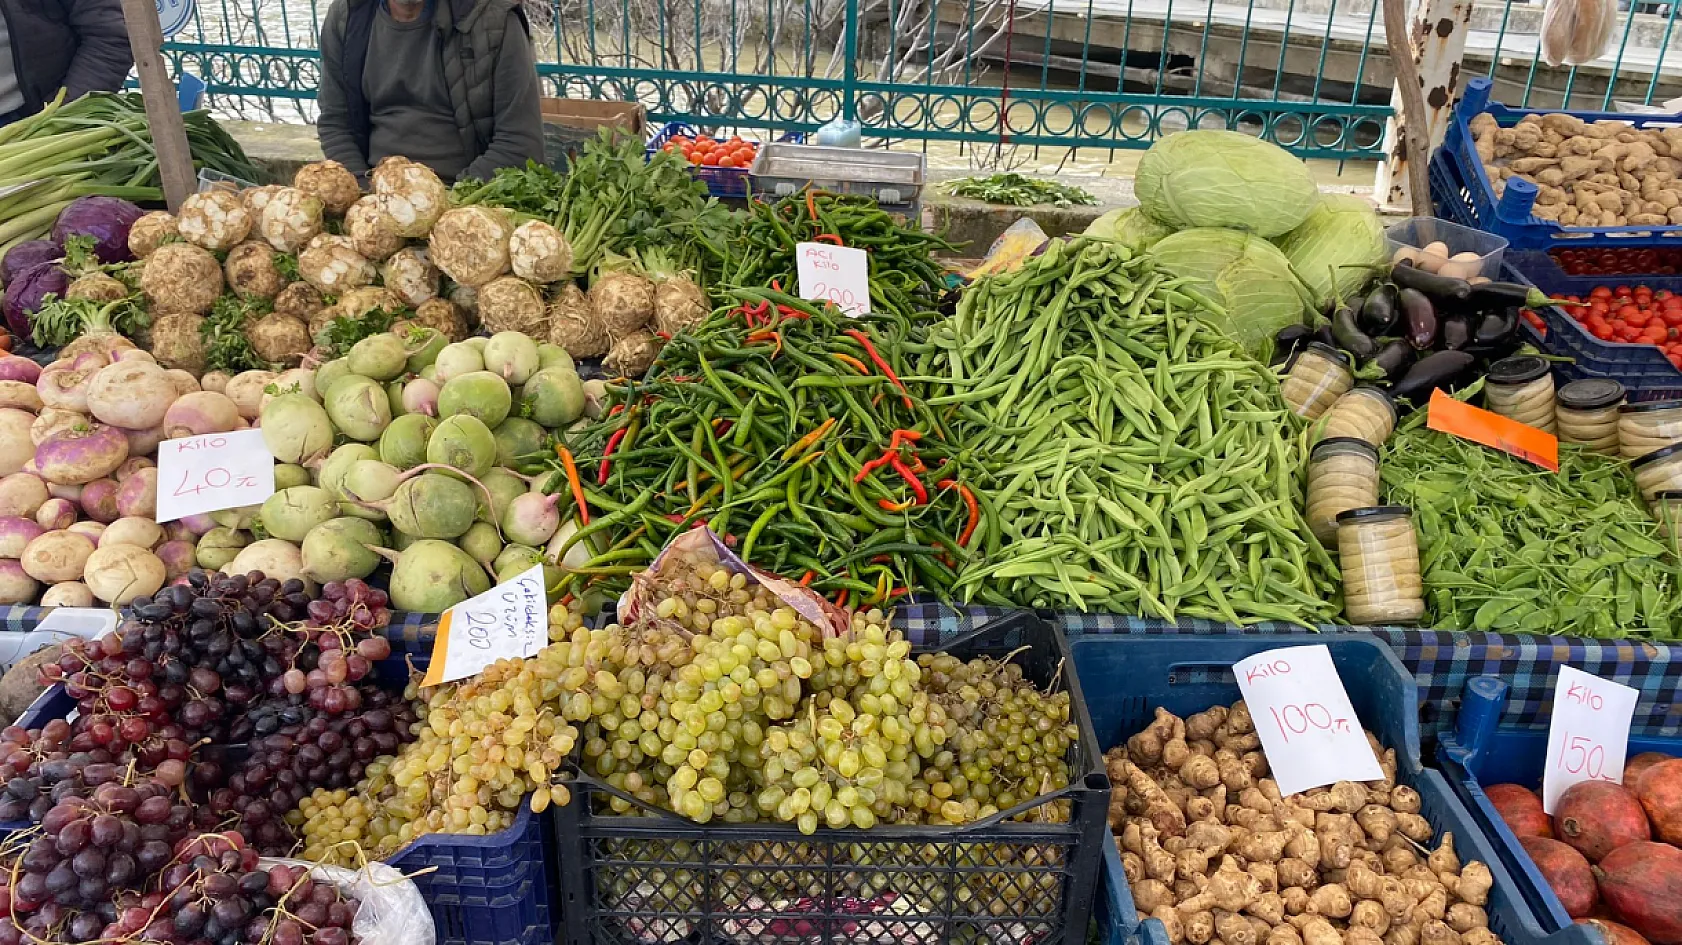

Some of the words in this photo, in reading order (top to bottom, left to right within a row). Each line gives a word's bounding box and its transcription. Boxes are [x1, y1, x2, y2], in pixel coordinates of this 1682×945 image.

[813, 281, 855, 306] 200
[172, 467, 232, 497] 40
[465, 611, 498, 650] 200
